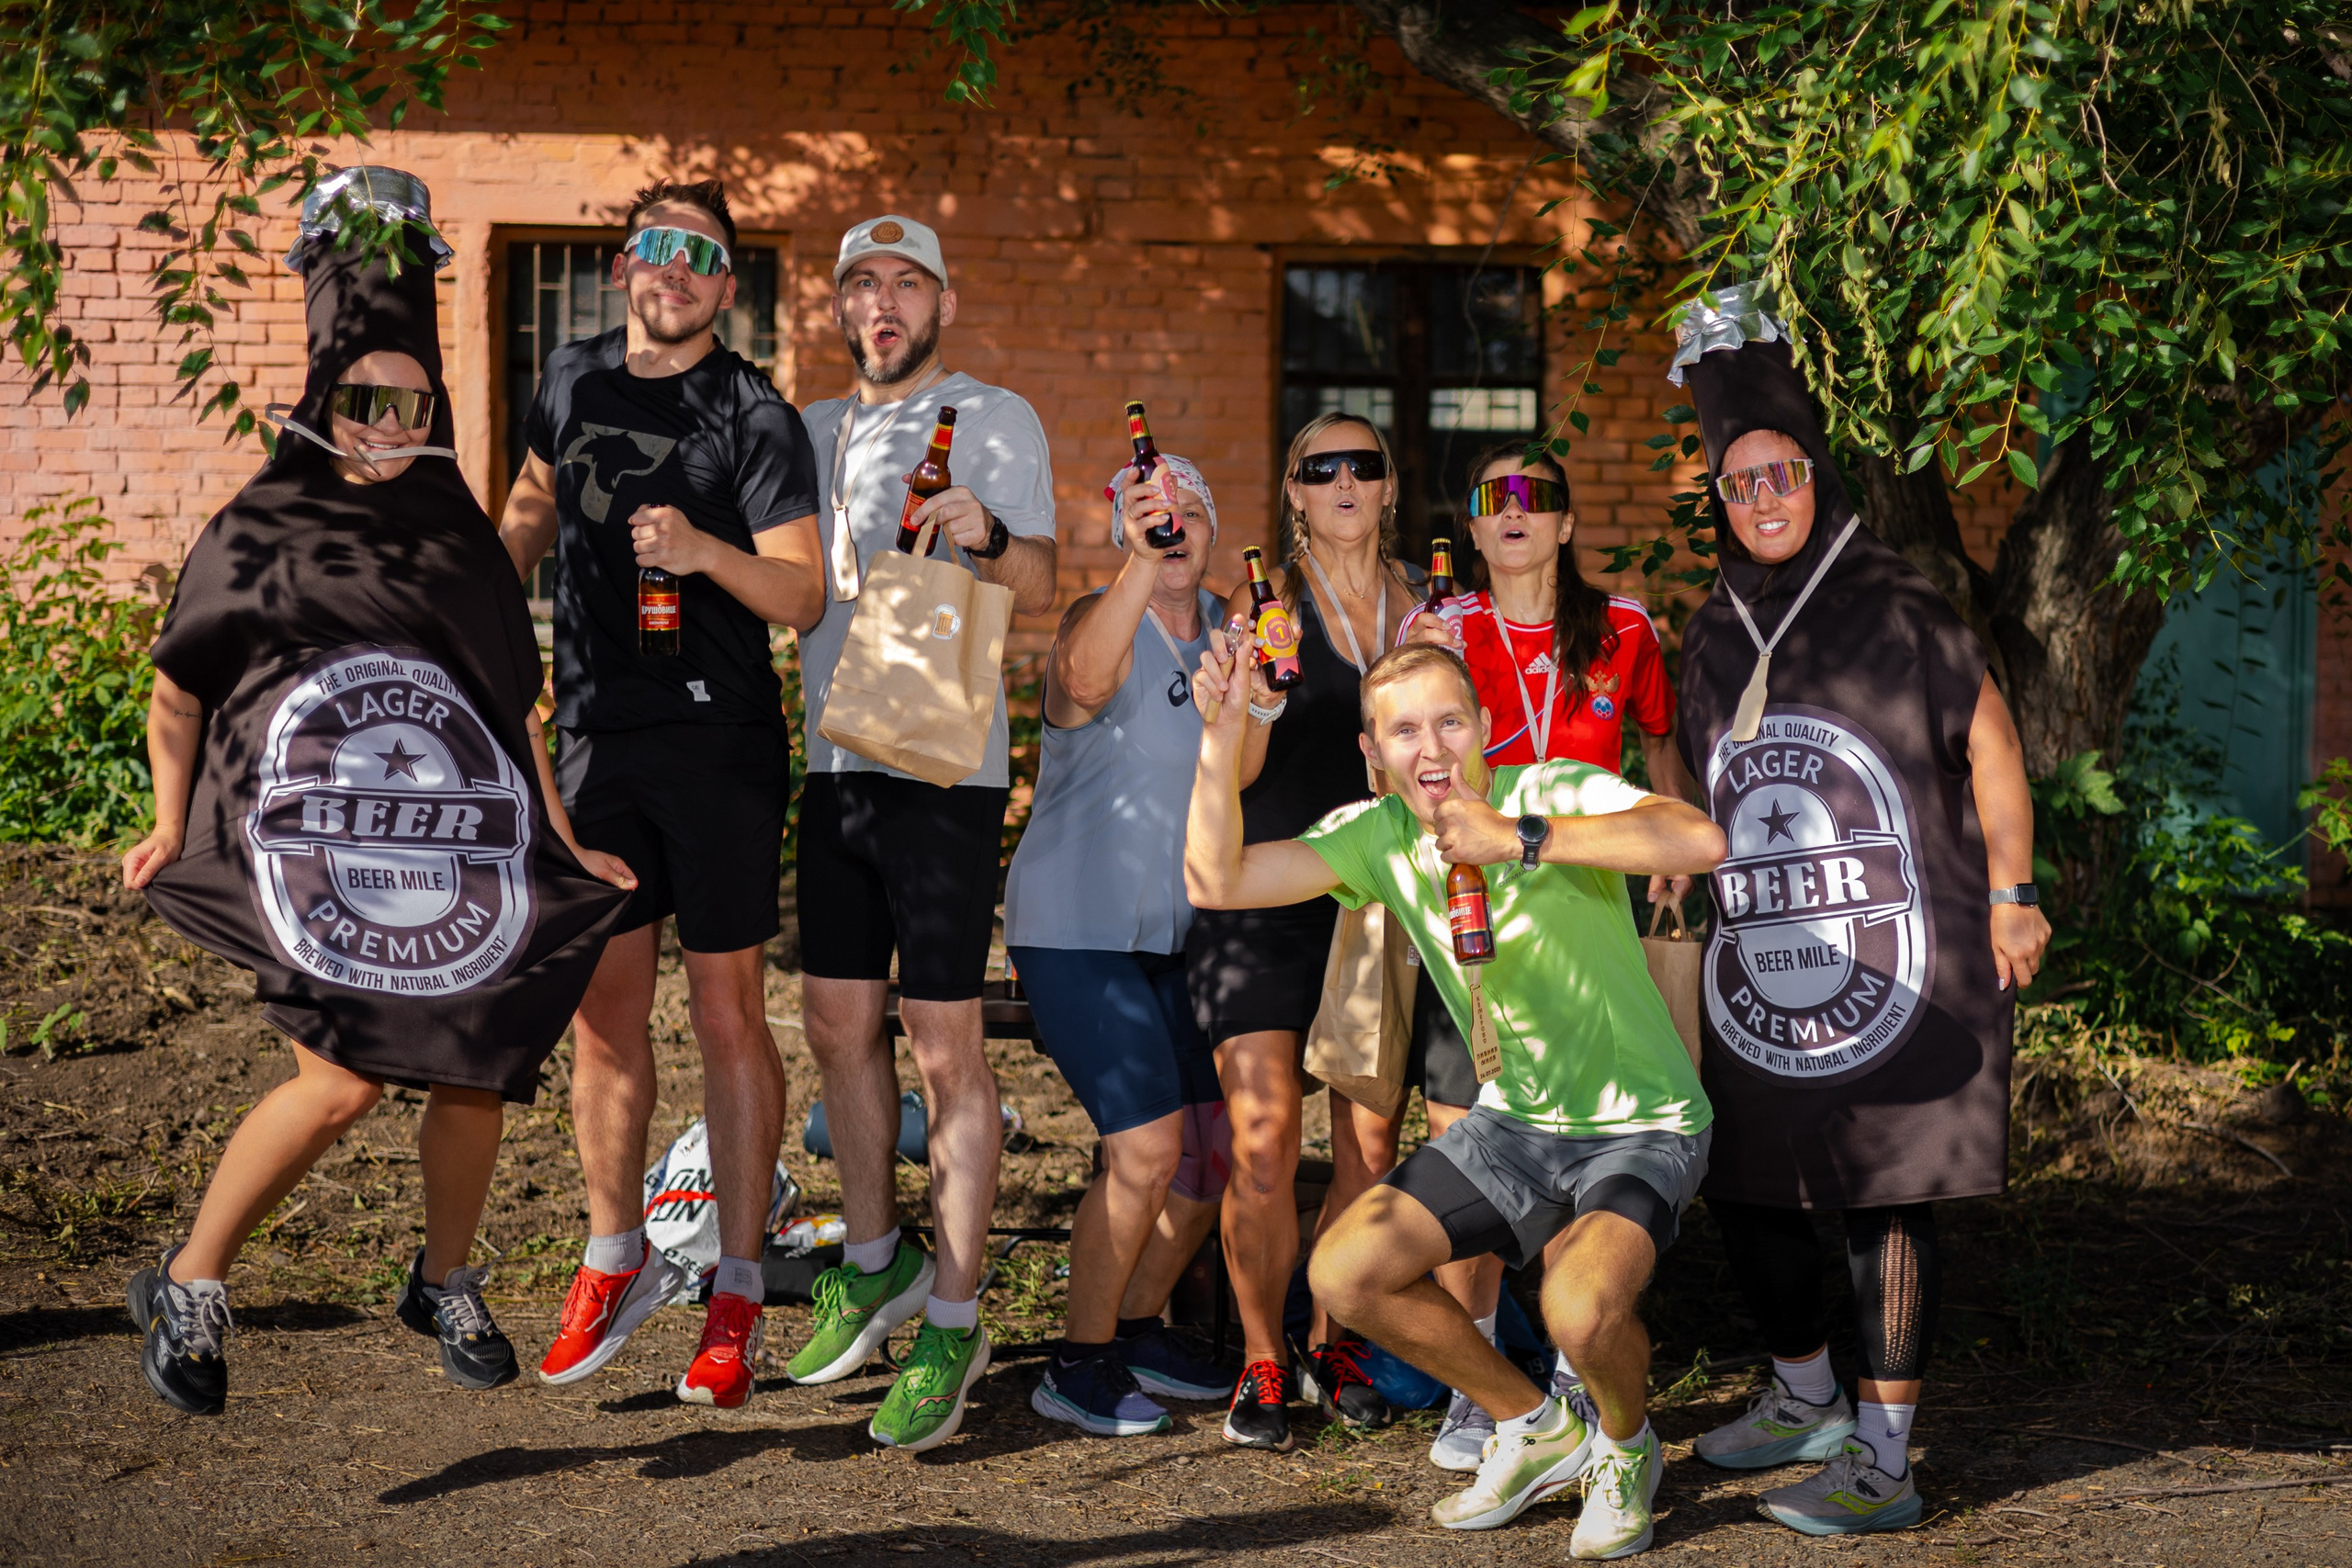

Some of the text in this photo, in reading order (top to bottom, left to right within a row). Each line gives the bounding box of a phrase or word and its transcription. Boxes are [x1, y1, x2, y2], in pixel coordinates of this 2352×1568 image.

[1275, 626, 1284, 639] 1
[1454, 626, 1462, 640] 2
[315, 671, 342, 695] THE
[345, 660, 407, 683] ORIGINAL
[1525, 665, 1560, 675] adid
[335, 687, 450, 729] LAGER
[1719, 742, 1731, 765] THE
[1785, 723, 1840, 748] QUALITY
[1728, 750, 1825, 794] LAGER
[300, 795, 483, 841] BEER
[346, 867, 446, 892] BEER MILE
[1721, 856, 1871, 919] BEER
[307, 899, 492, 964] PREMIUM
[293, 933, 509, 992] BREWED WITH NATURAL INGRIDIENT
[1754, 942, 1840, 974] BEER MILE
[1730, 971, 1886, 1045] PREMIUM
[1721, 1001, 1907, 1072] BREWED WITH NATURAL INGRIDIENT
